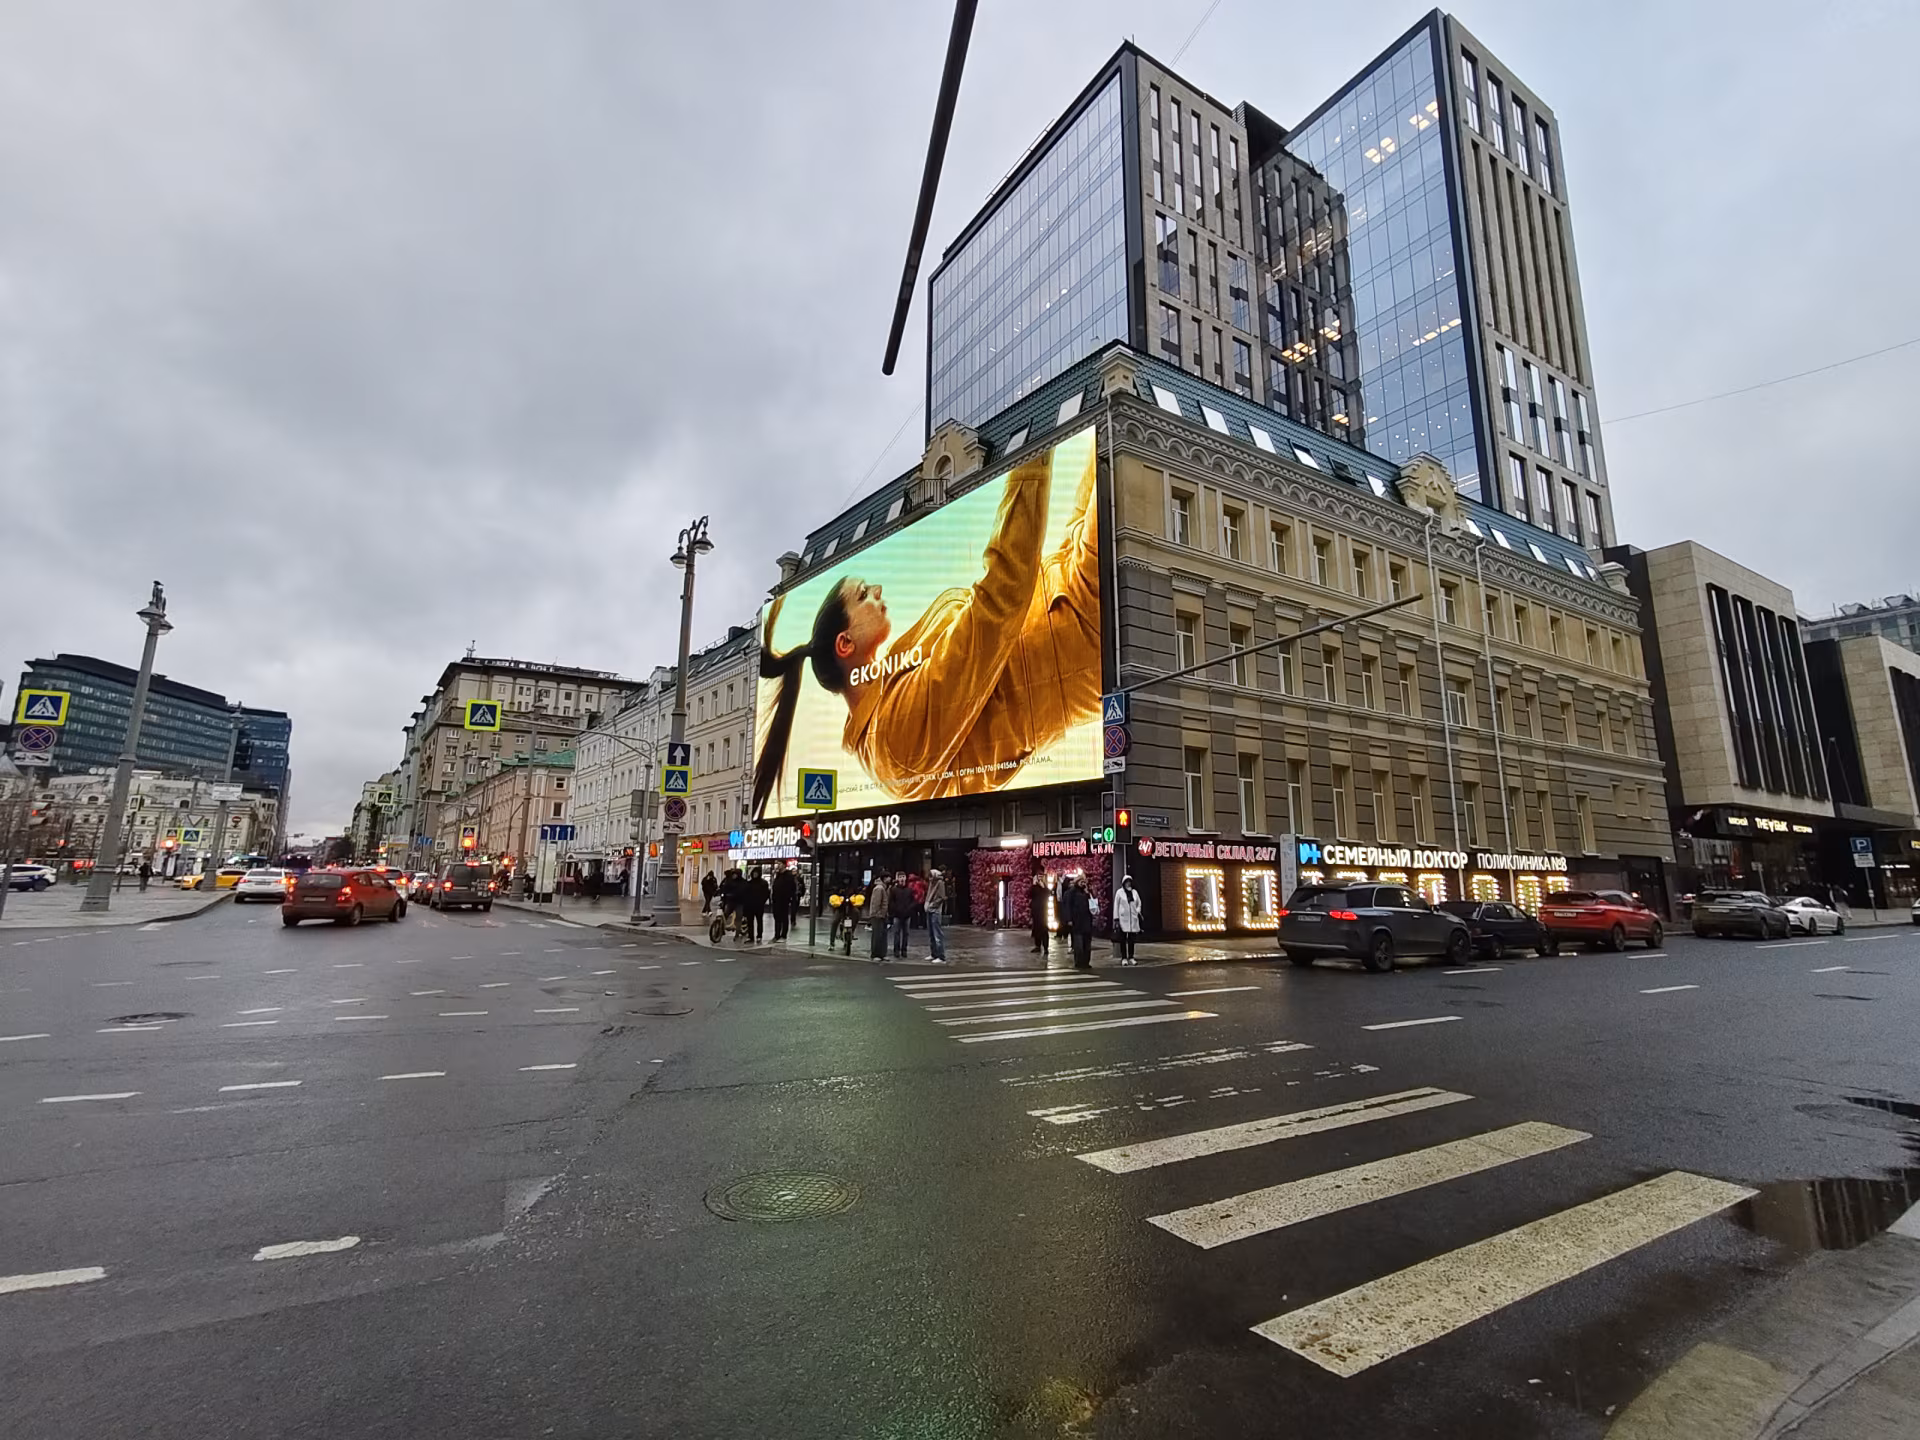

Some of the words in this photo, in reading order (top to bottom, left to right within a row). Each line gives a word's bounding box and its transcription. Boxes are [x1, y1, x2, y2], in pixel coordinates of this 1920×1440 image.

[744, 826, 801, 847] СЕМЕЙНЫ
[1032, 838, 1087, 858] ЦВЕТОЧНЫЙ
[1216, 844, 1256, 862] СКЛАД
[1255, 846, 1277, 861] 24/7
[1323, 844, 1411, 867] СЕМЕЙНЫЙ
[1412, 850, 1468, 870] ДОКТОР
[1477, 852, 1551, 871] ПОЛИКЛИНИКА
